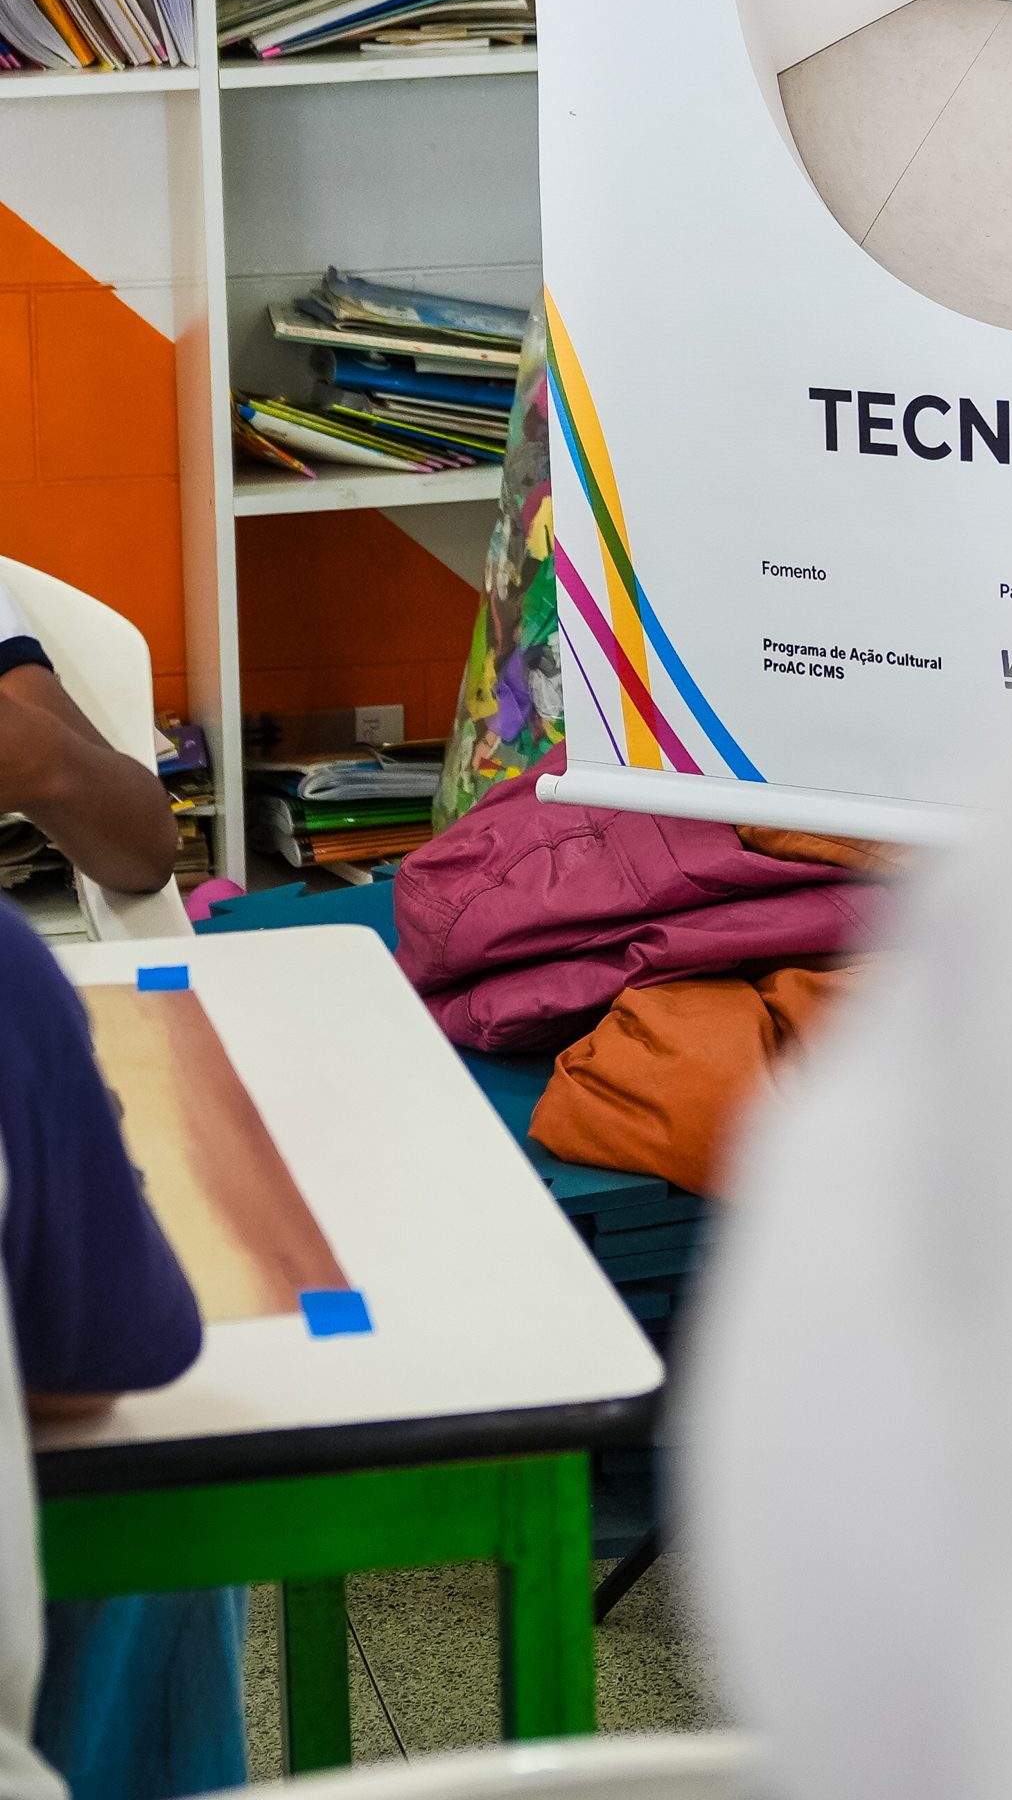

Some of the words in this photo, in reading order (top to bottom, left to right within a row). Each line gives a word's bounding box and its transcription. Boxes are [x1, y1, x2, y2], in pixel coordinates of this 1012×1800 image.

[762, 560, 827, 581] Fomento
[763, 638, 827, 657] Programa
[830, 646, 846, 660] de
[849, 647, 883, 666] Ação
[886, 651, 942, 670] Cultural
[763, 658, 806, 675] ProAC
[809, 663, 845, 680] ICMS
